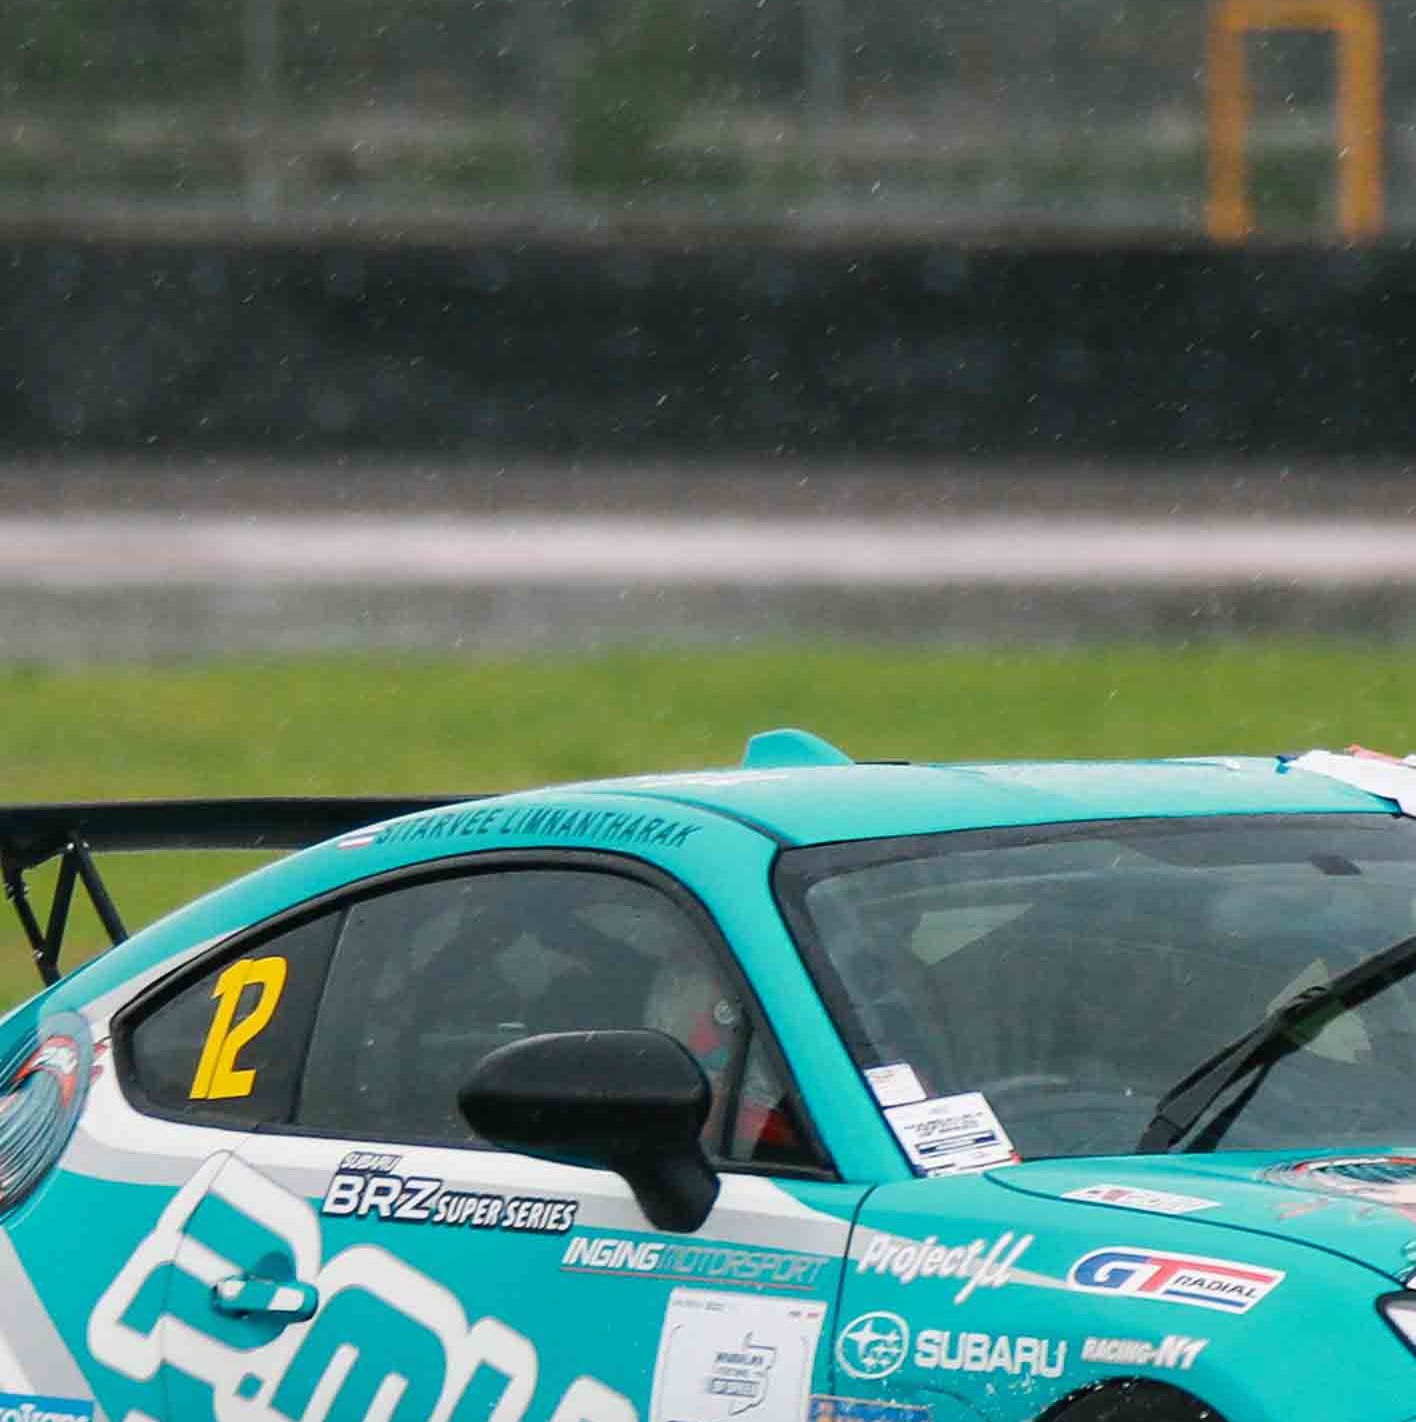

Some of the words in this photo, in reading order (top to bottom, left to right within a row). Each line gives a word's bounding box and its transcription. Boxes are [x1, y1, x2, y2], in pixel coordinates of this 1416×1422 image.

[191, 956, 288, 1101] 12
[321, 1174, 443, 1221] BRZ
[433, 1194, 505, 1227] SUPER
[502, 1198, 578, 1232] SERIES
[561, 1237, 665, 1271] INGING
[856, 1233, 987, 1284] Project
[1072, 1251, 1245, 1292] GT
[1171, 1275, 1260, 1299] RADIAL
[914, 1329, 1068, 1379] SUBARU
